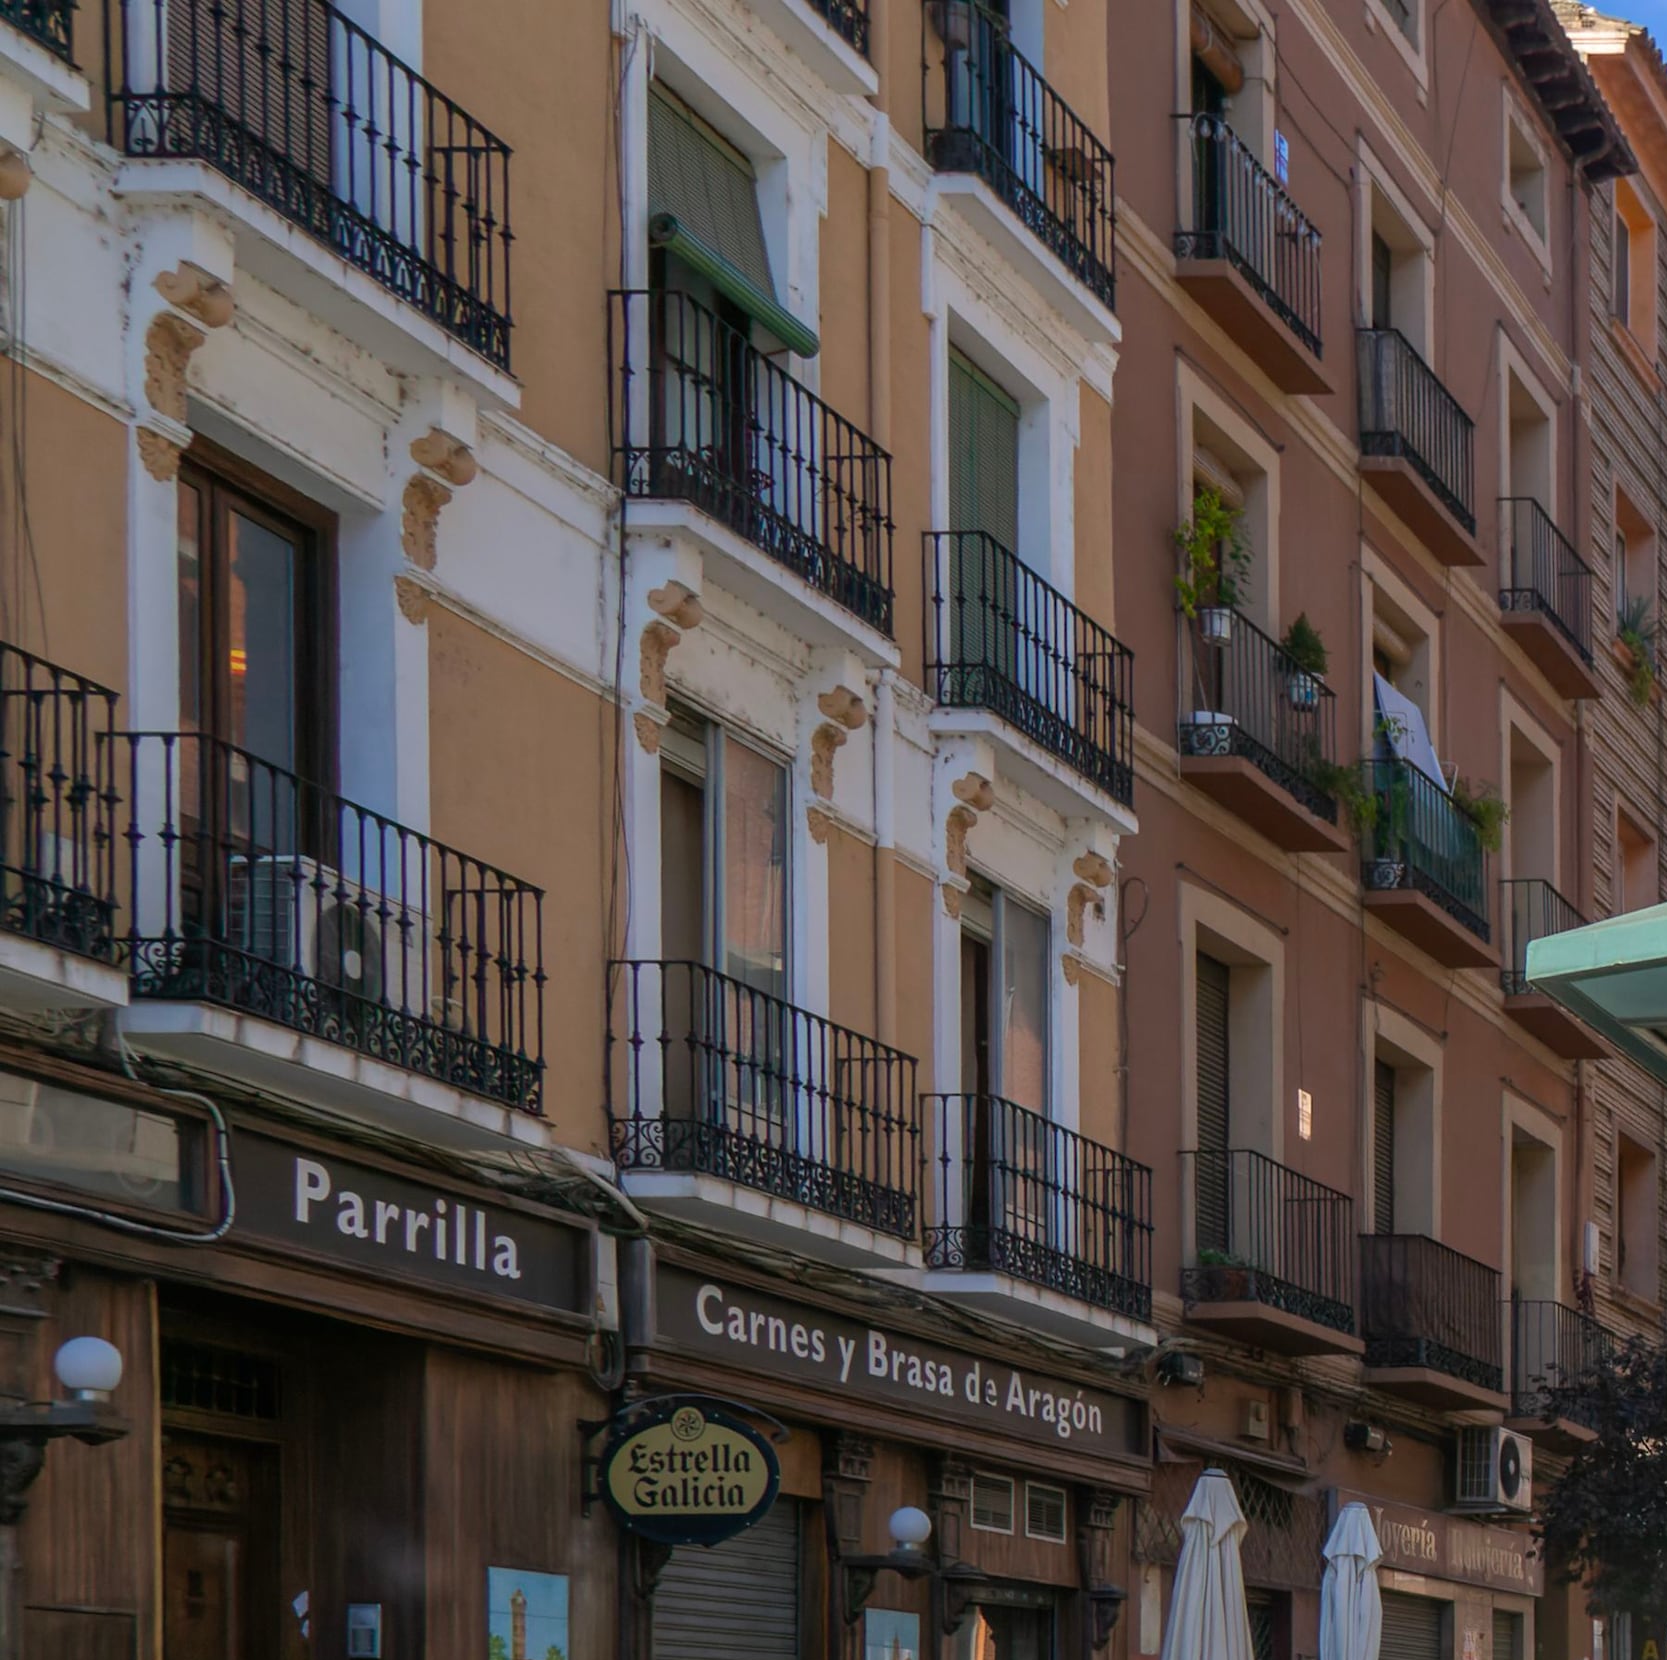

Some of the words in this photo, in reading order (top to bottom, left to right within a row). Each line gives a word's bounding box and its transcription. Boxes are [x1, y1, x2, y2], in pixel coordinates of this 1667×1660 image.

[296, 1157, 522, 1280] Parrilla
[696, 1284, 826, 1364] Carnes
[837, 1334, 857, 1384] y
[867, 1329, 955, 1397] Brasa
[965, 1361, 998, 1407] de
[1005, 1371, 1103, 1439] Aragón
[628, 1443, 752, 1474] Estrella
[634, 1476, 744, 1509] Galicia
